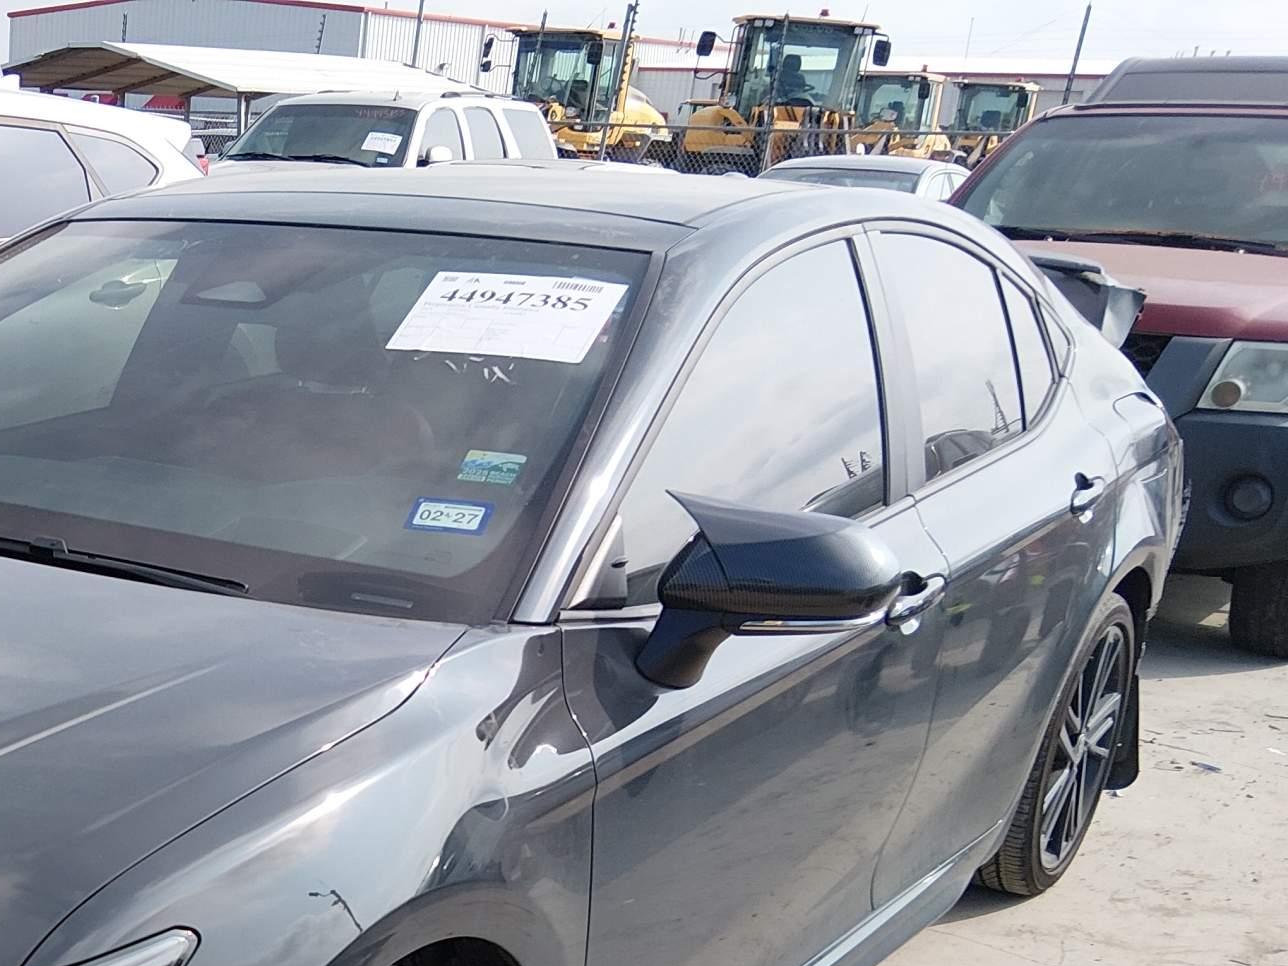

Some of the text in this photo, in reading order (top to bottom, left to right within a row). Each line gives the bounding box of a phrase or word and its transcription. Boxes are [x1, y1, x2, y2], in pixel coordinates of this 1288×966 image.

[440, 289, 593, 312] 44947385
[419, 508, 479, 525] 02 27
